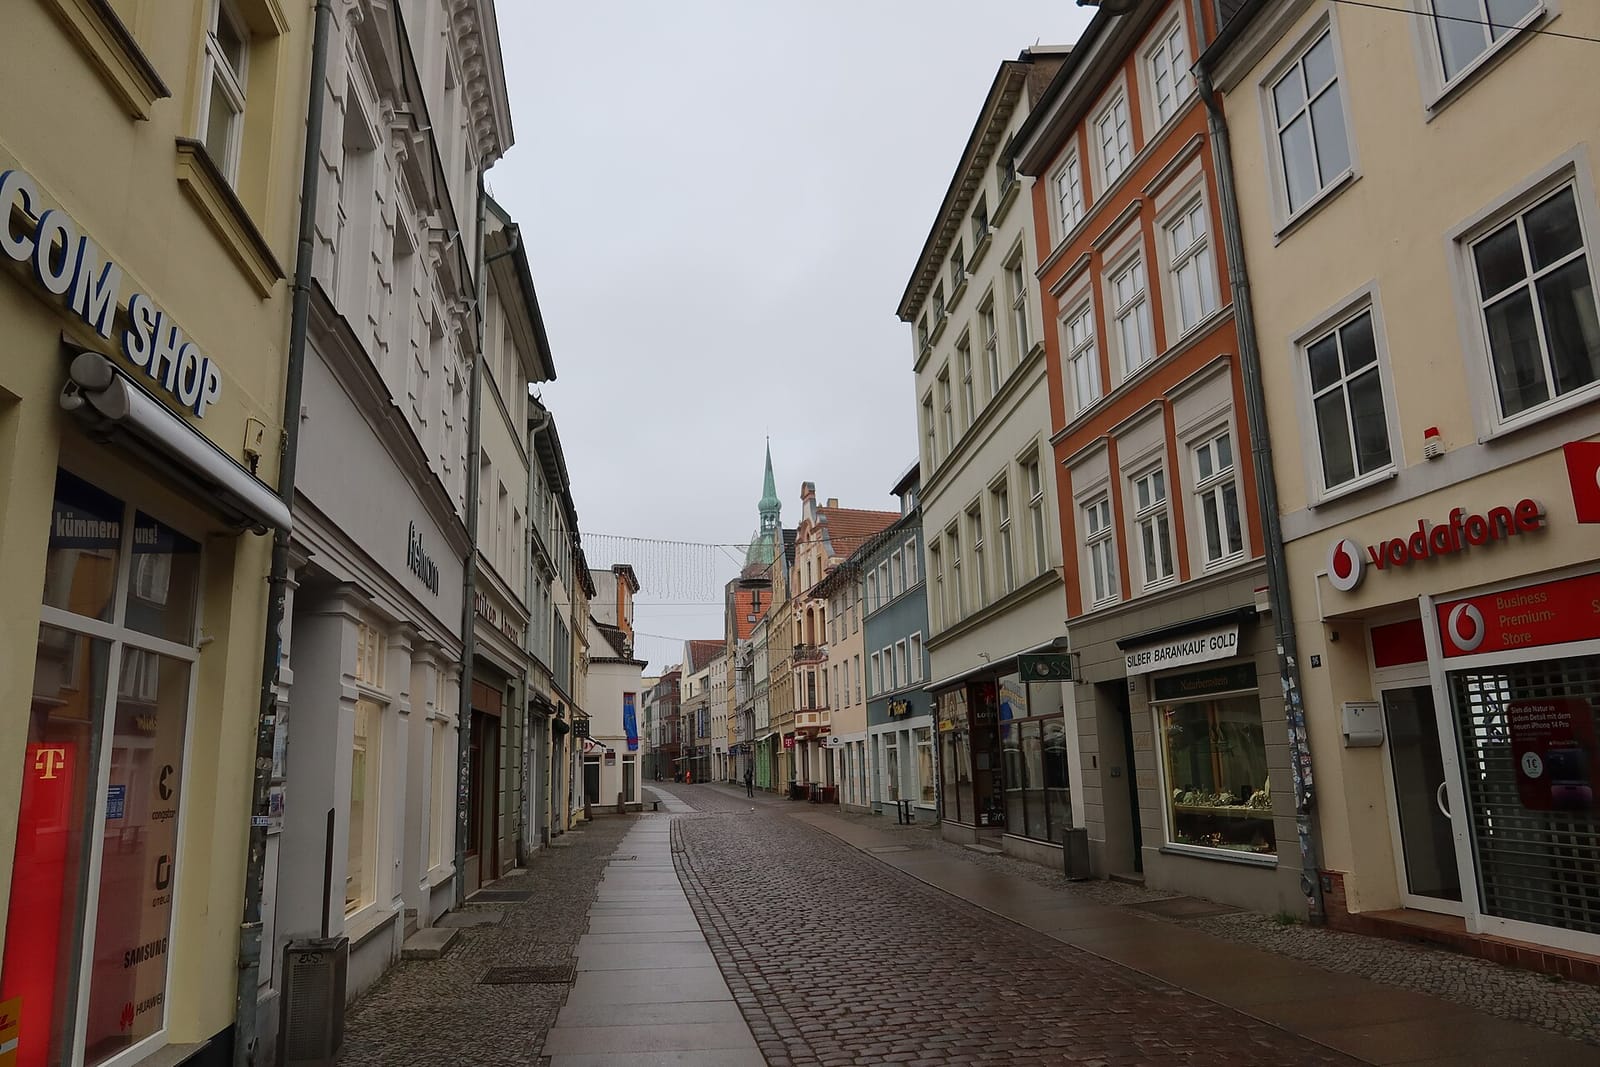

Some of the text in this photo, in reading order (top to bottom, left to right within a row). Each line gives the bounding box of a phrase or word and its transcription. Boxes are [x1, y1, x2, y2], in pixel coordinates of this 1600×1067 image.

[0, 170, 222, 418] COM SHOP
[56, 512, 159, 544] kümmern uns!
[1367, 498, 1544, 570] vodafone
[1496, 591, 1548, 610] Business
[1499, 609, 1556, 628] Premium-
[1127, 632, 1236, 668] SILBER BARANKAUF GOLD
[1502, 632, 1532, 646] Store
[1022, 660, 1069, 677] VOSS
[1530, 713, 1546, 721] Detail
[35, 748, 65, 780] T
[123, 937, 167, 969] SAMSUNG
[135, 991, 163, 1017] HUAWEI
